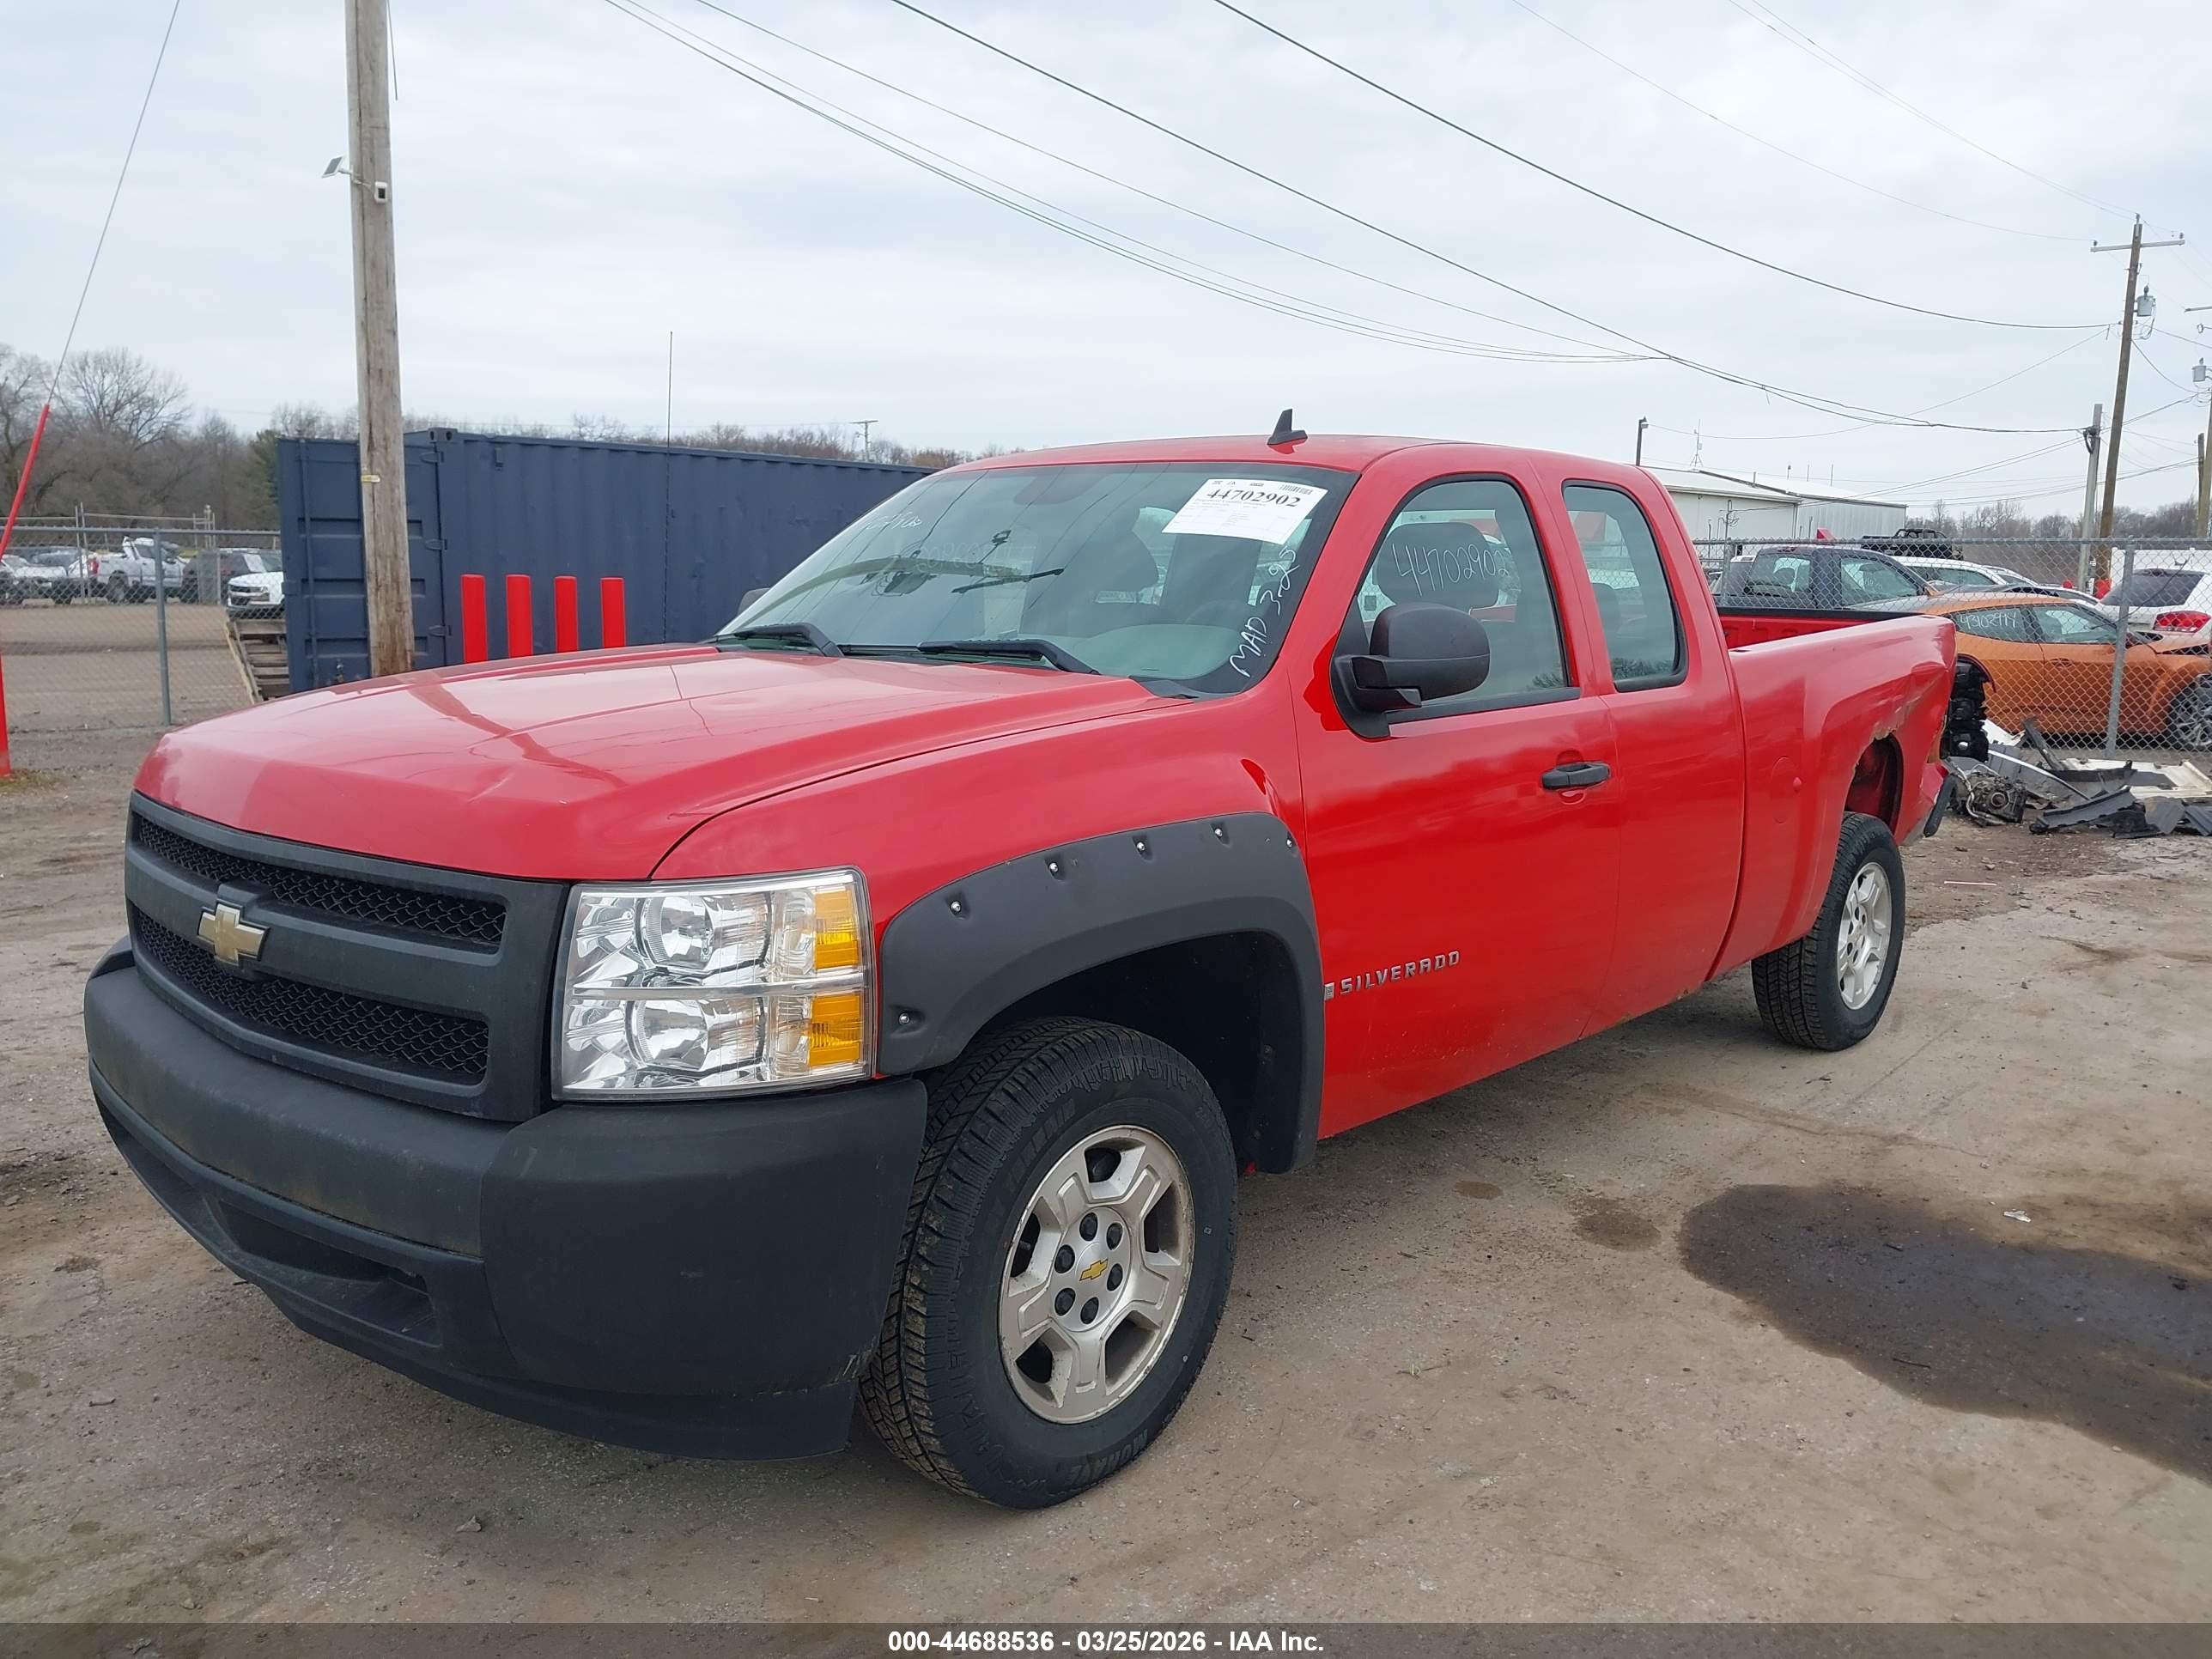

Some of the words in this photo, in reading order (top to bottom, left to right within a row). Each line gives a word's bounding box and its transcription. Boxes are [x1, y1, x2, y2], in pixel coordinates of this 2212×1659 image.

[1207, 489, 1301, 507] 44702902
[1392, 543, 1510, 597] 44702902
[1229, 617, 1267, 678] MAD
[1340, 951, 1460, 994] SILVERADO
